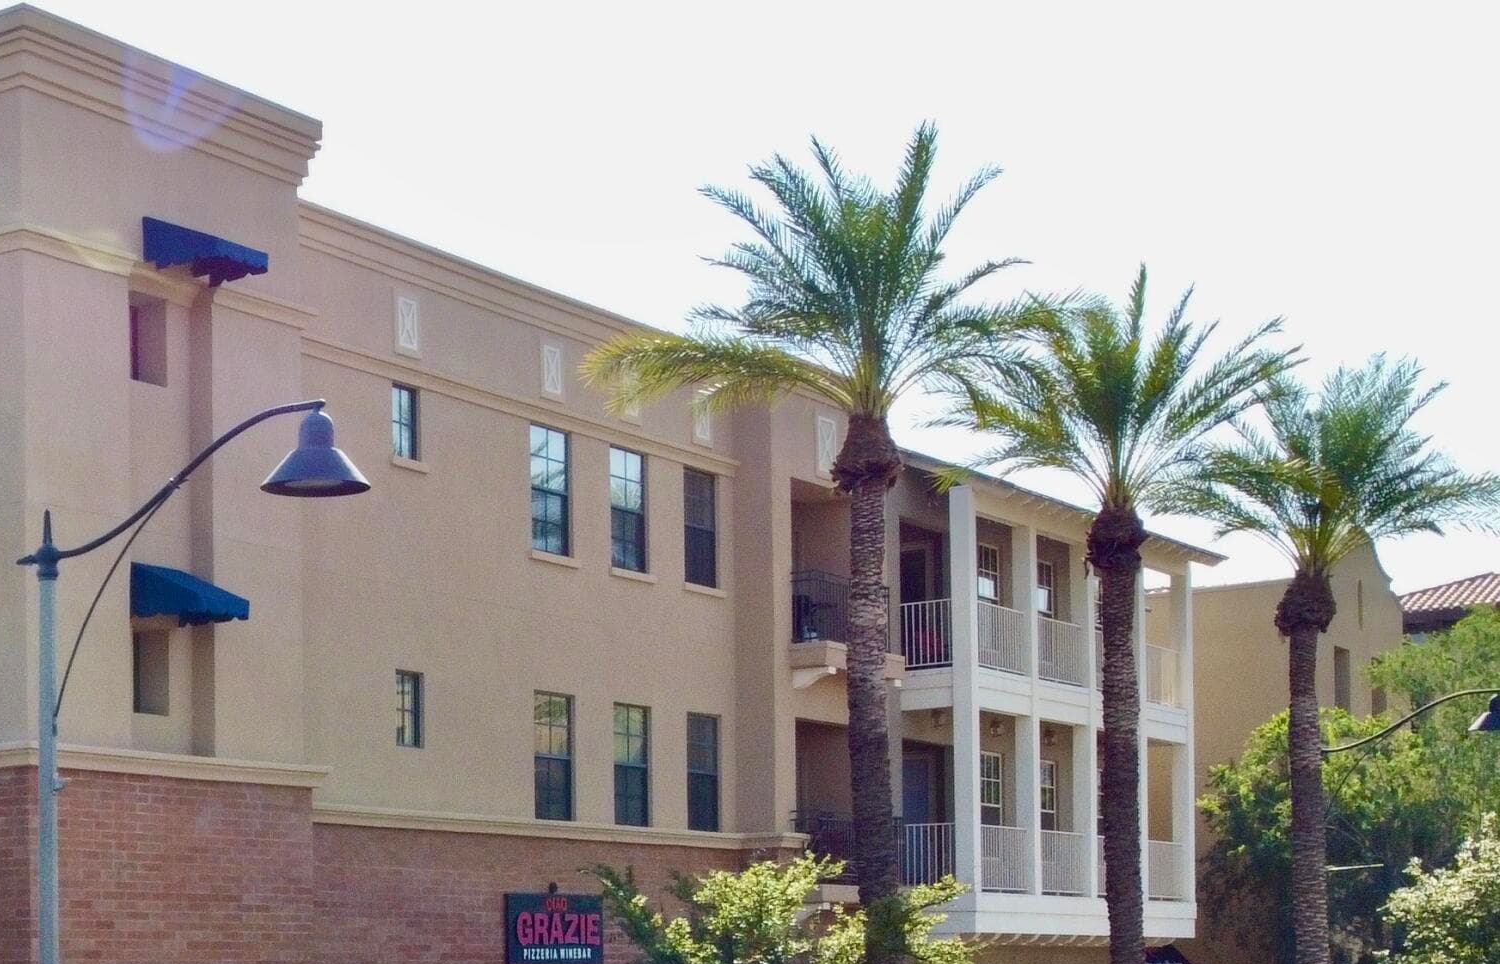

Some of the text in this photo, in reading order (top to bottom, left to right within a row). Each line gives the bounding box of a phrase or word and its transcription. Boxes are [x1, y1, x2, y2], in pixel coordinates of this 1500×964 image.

[516, 911, 600, 945] GRAZIE
[523, 947, 592, 960] PIZZERIA WINEBAR
